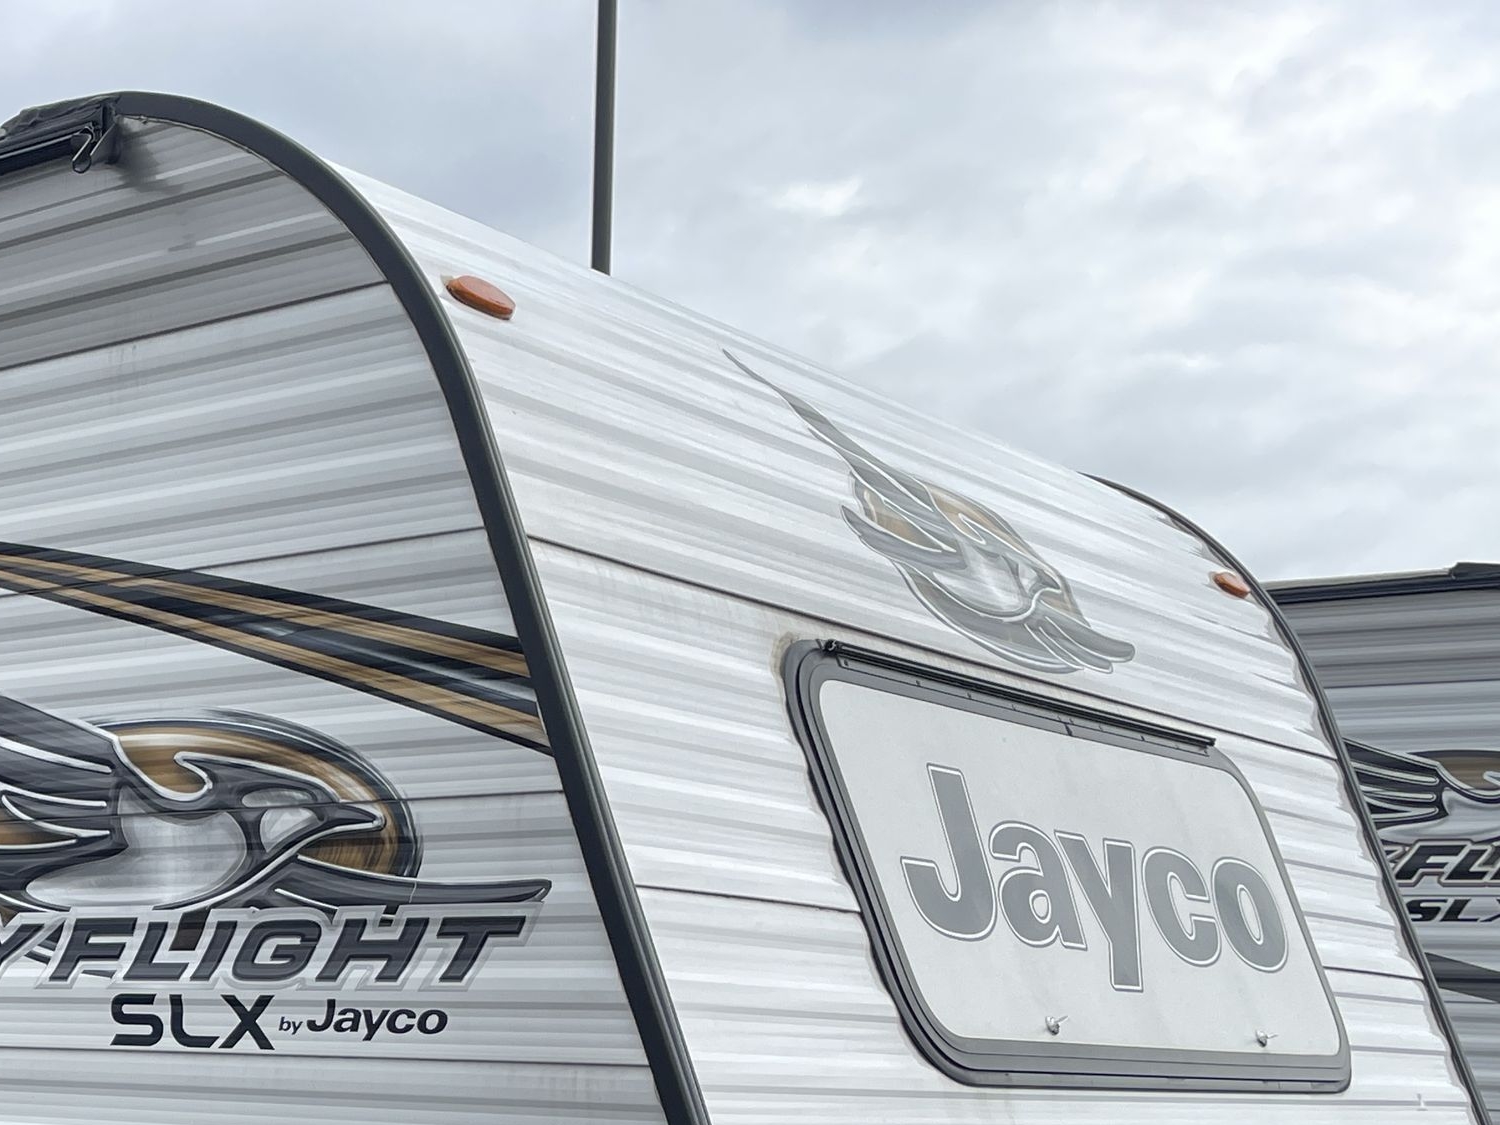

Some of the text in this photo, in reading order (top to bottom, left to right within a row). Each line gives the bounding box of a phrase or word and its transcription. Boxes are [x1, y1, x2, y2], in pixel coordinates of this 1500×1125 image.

[900, 762, 1289, 993] Jayco
[50, 914, 528, 984] FLIGHT
[110, 993, 449, 1050] SLX by Jayco
